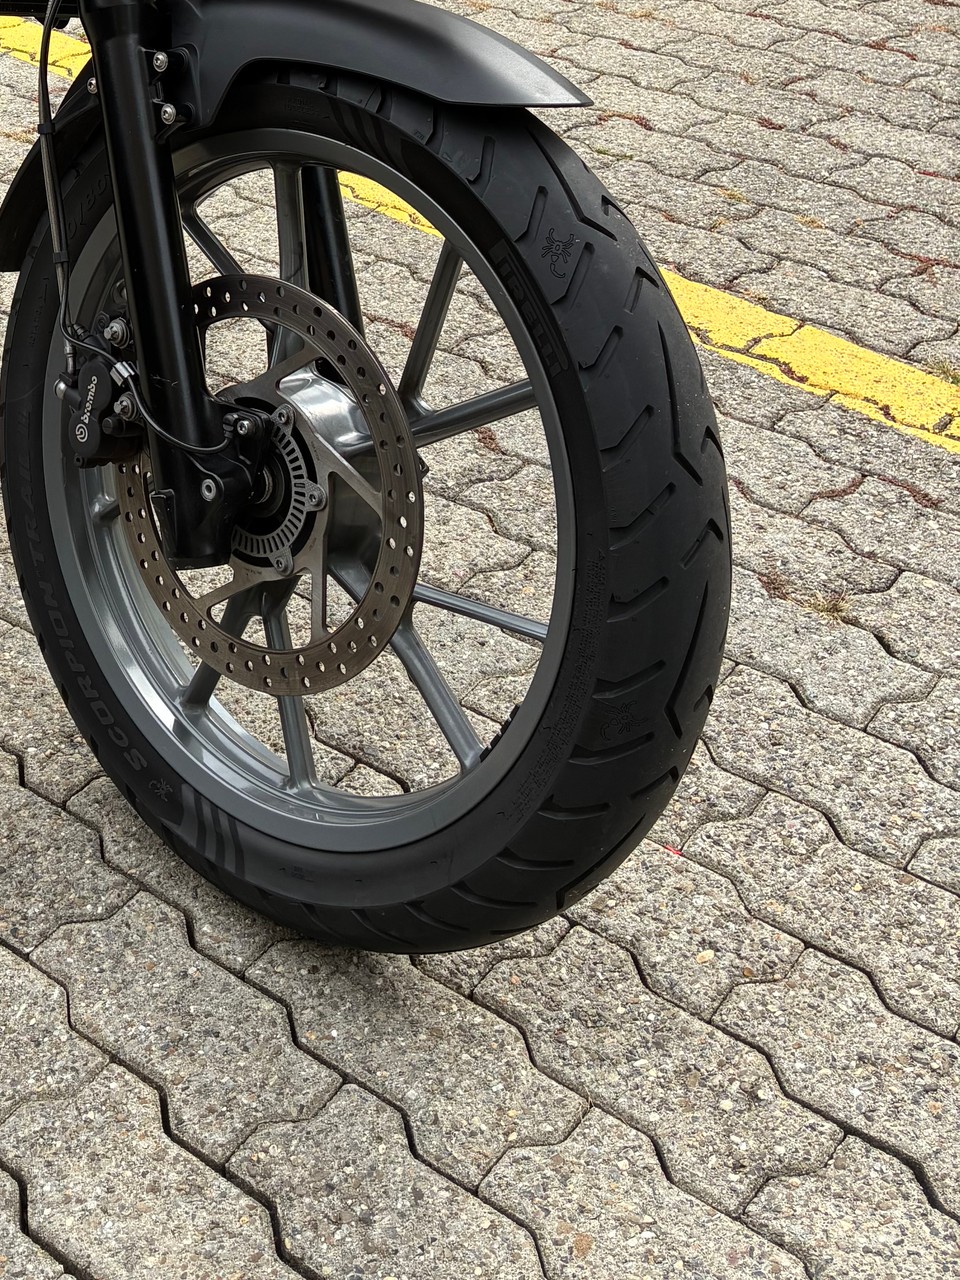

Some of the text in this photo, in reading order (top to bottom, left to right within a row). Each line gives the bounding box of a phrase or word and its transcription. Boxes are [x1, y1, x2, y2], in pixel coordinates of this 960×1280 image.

[490, 238, 569, 378] PIRELLI
[80, 375, 98, 424] brembo
[18, 449, 45, 567] TRAIL
[38, 580, 148, 771] SCORPION
